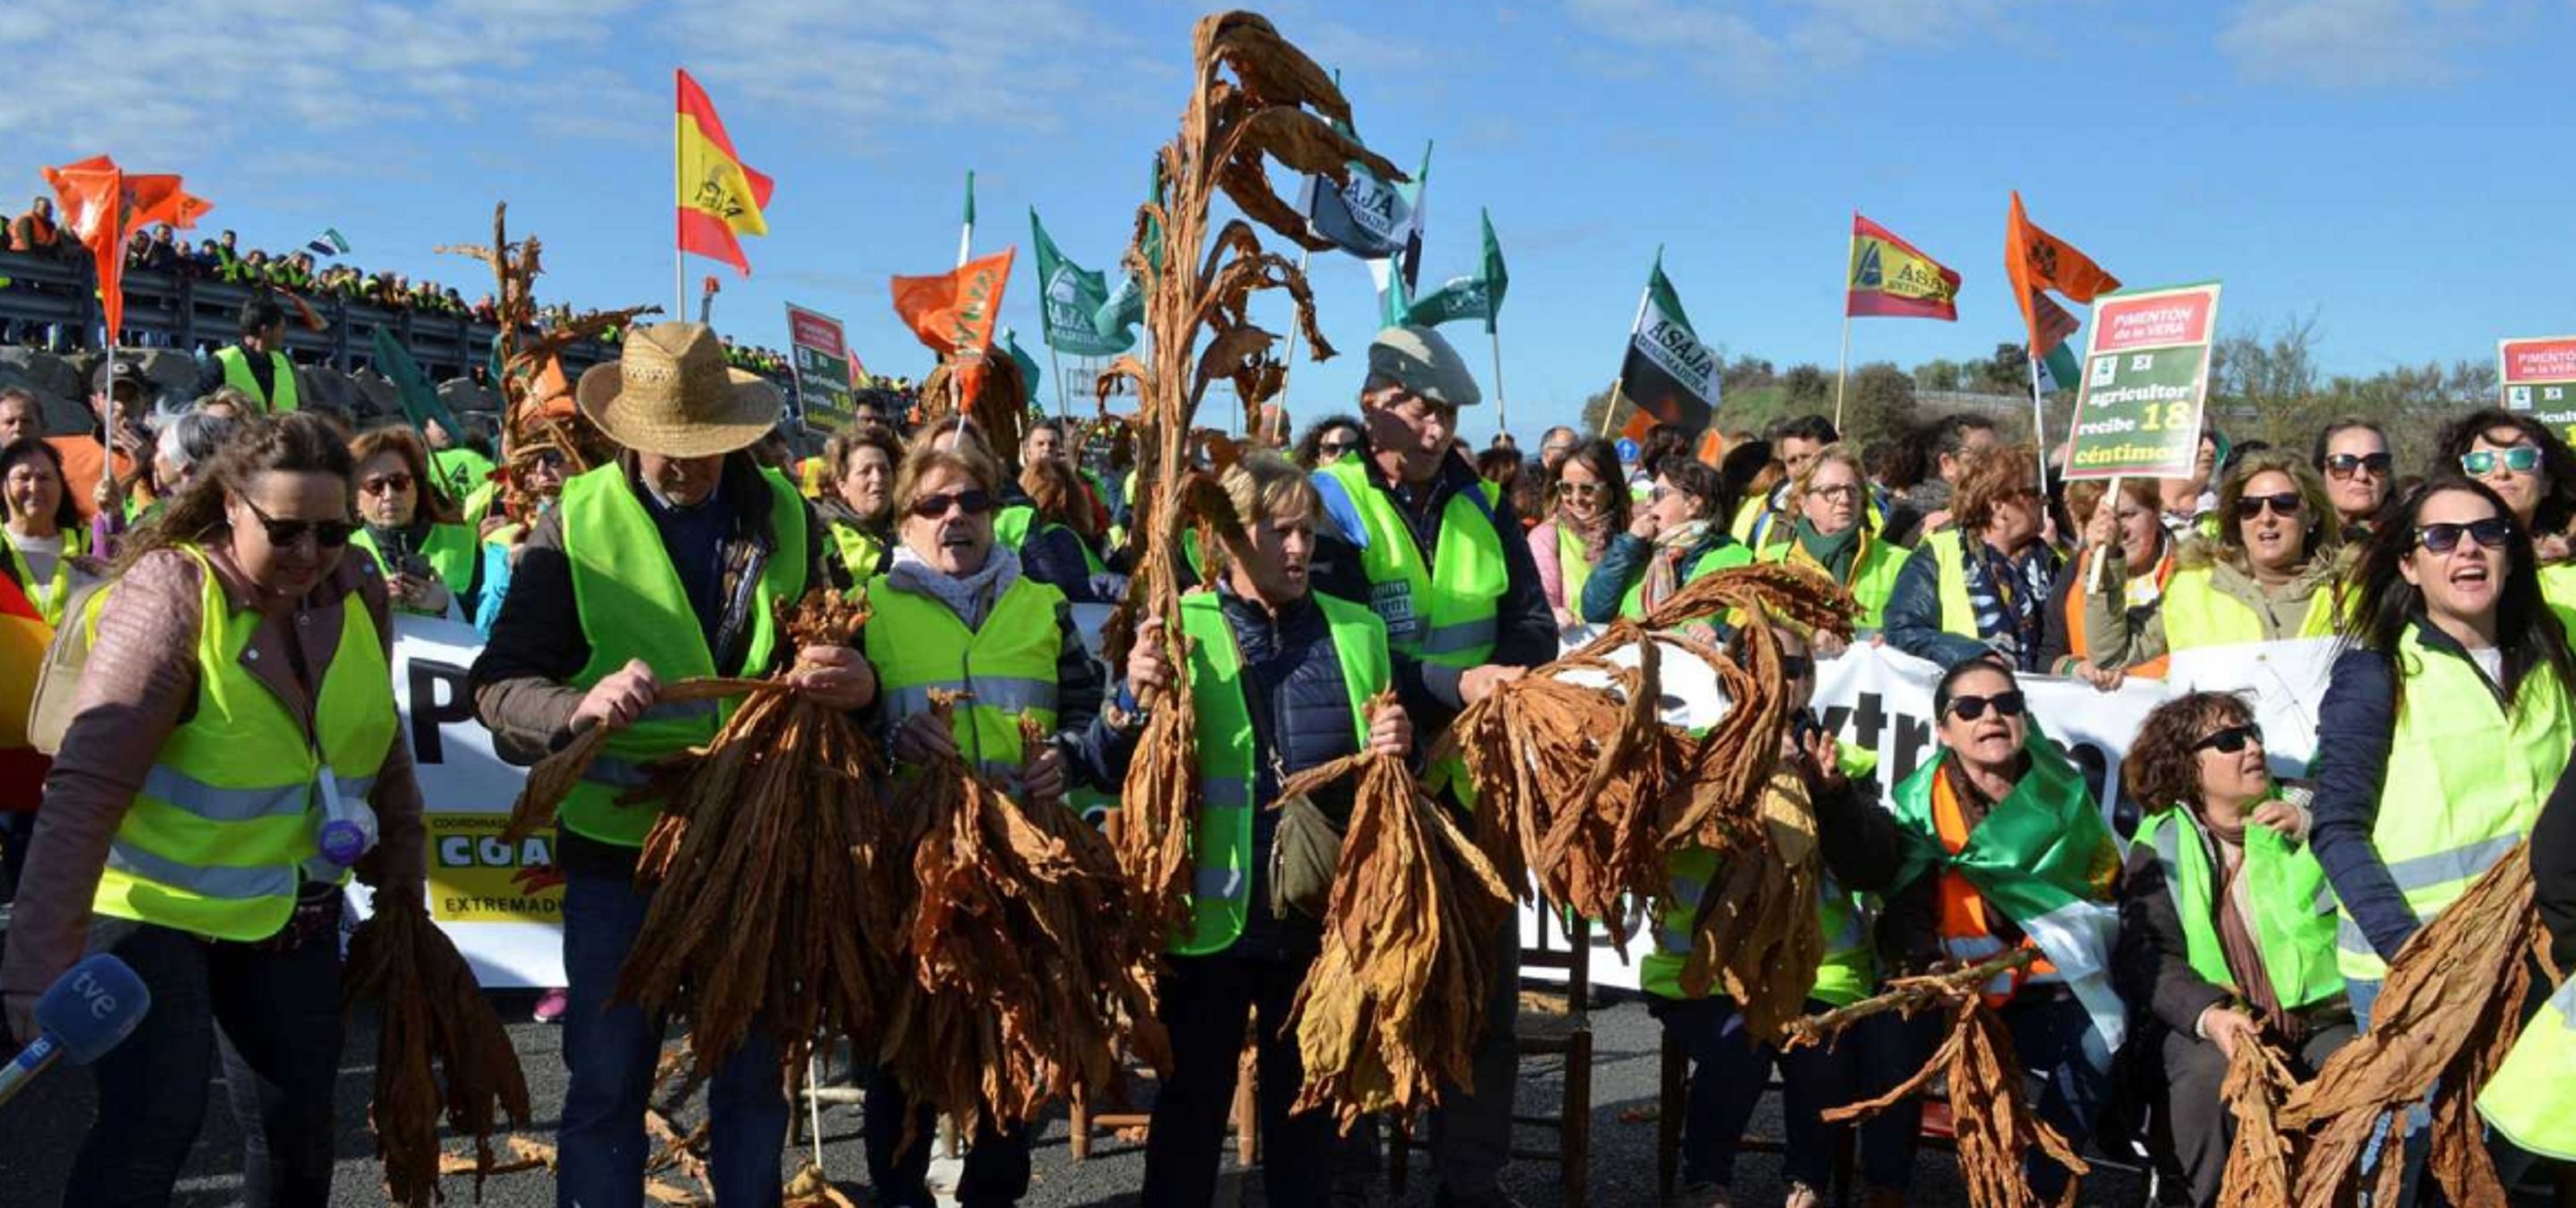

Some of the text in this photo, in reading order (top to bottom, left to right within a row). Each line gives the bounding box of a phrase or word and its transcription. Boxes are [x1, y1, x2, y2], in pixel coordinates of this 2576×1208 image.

[1343, 179, 1394, 220] AJA
[2147, 322, 2185, 337] VERA
[1648, 320, 1715, 380] ASAJA
[2089, 384, 2190, 407] agricultor
[2079, 402, 2191, 437] recibe 18
[72, 970, 117, 1019] tve
